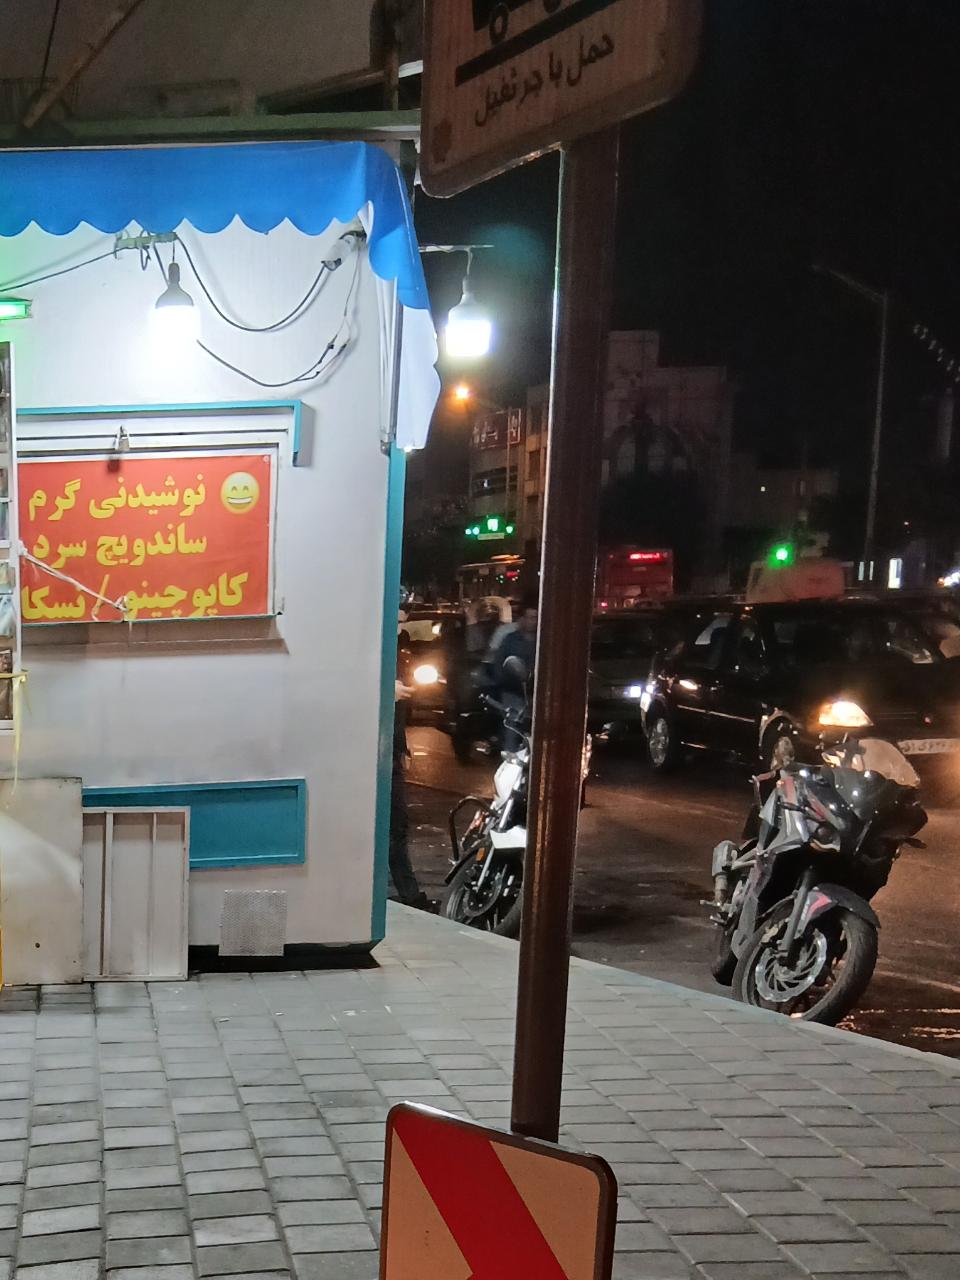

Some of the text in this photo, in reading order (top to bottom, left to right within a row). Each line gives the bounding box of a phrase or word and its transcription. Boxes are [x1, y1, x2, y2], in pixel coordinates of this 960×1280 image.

[548, 51, 564, 89] با
[566, 32, 616, 87] حمل
[28, 473, 206, 522] نوشیدنی گرم
[32, 522, 208, 570] ساندویچ سرد
